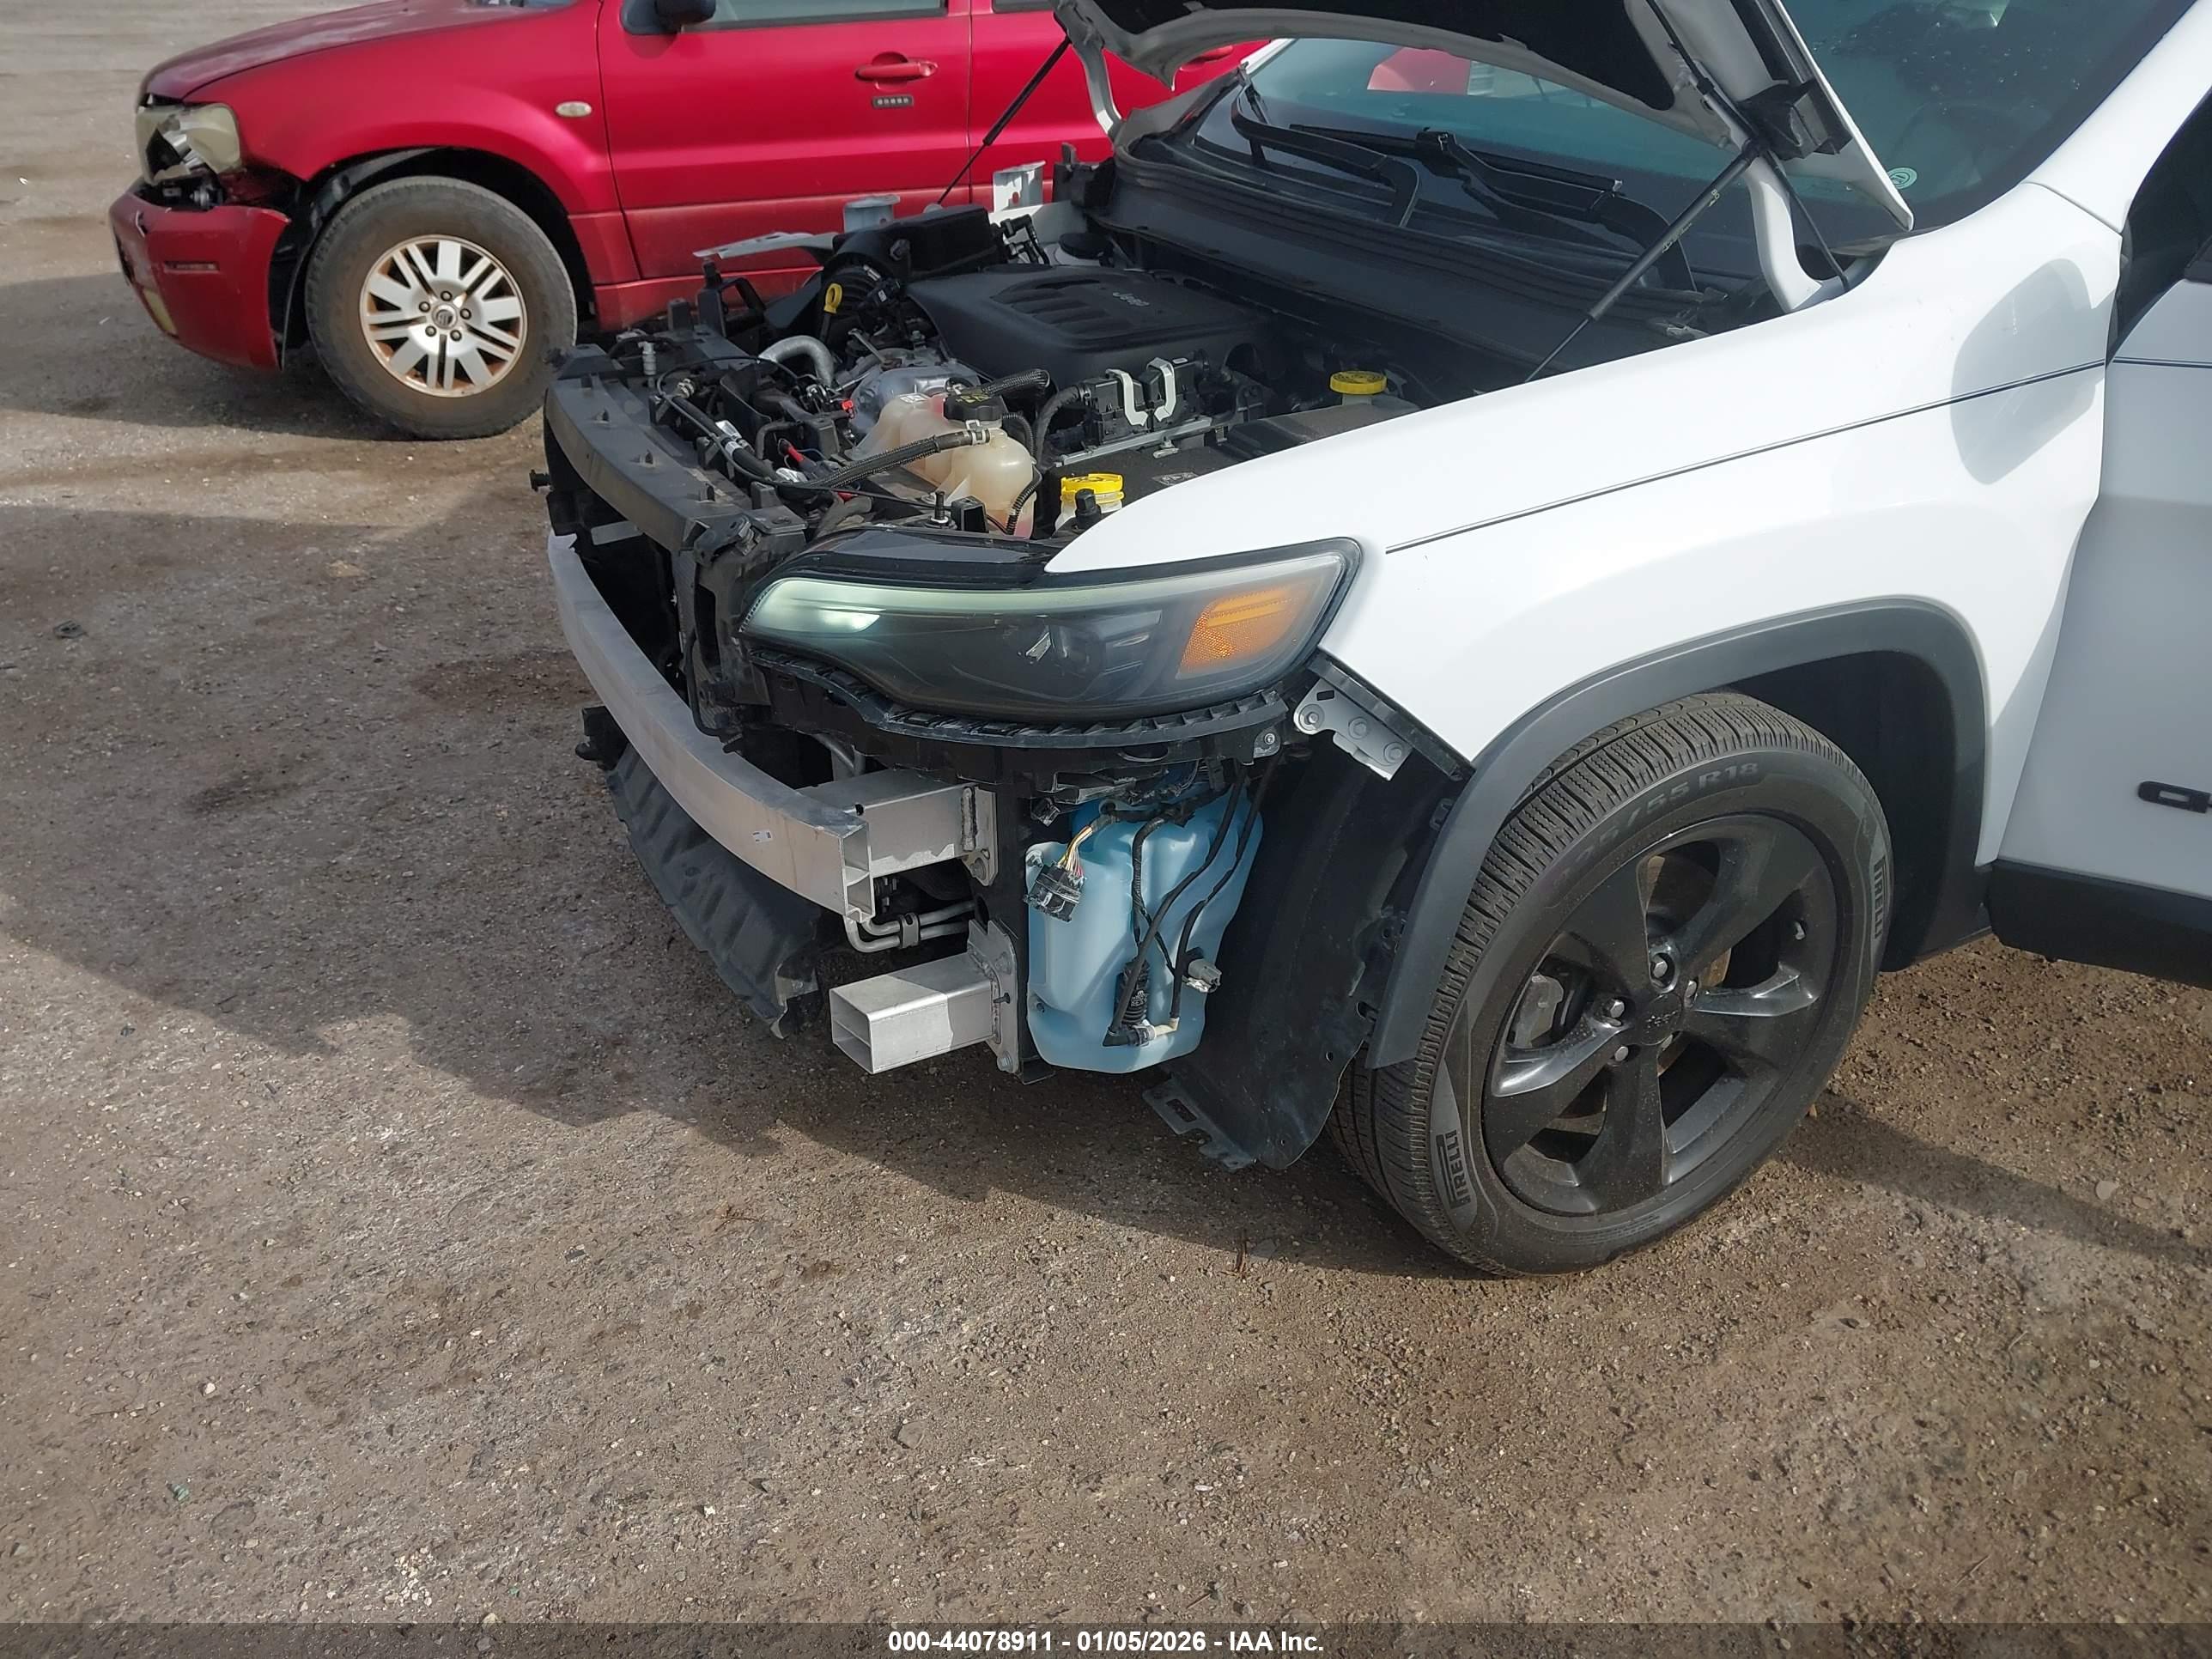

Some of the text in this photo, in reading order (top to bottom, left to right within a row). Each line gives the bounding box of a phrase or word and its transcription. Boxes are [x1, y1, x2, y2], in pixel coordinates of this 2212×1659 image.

[1698, 763, 1759, 790] R18
[1874, 855, 1888, 939] PIRELLI
[1436, 1129, 1471, 1210] PIRELLI
